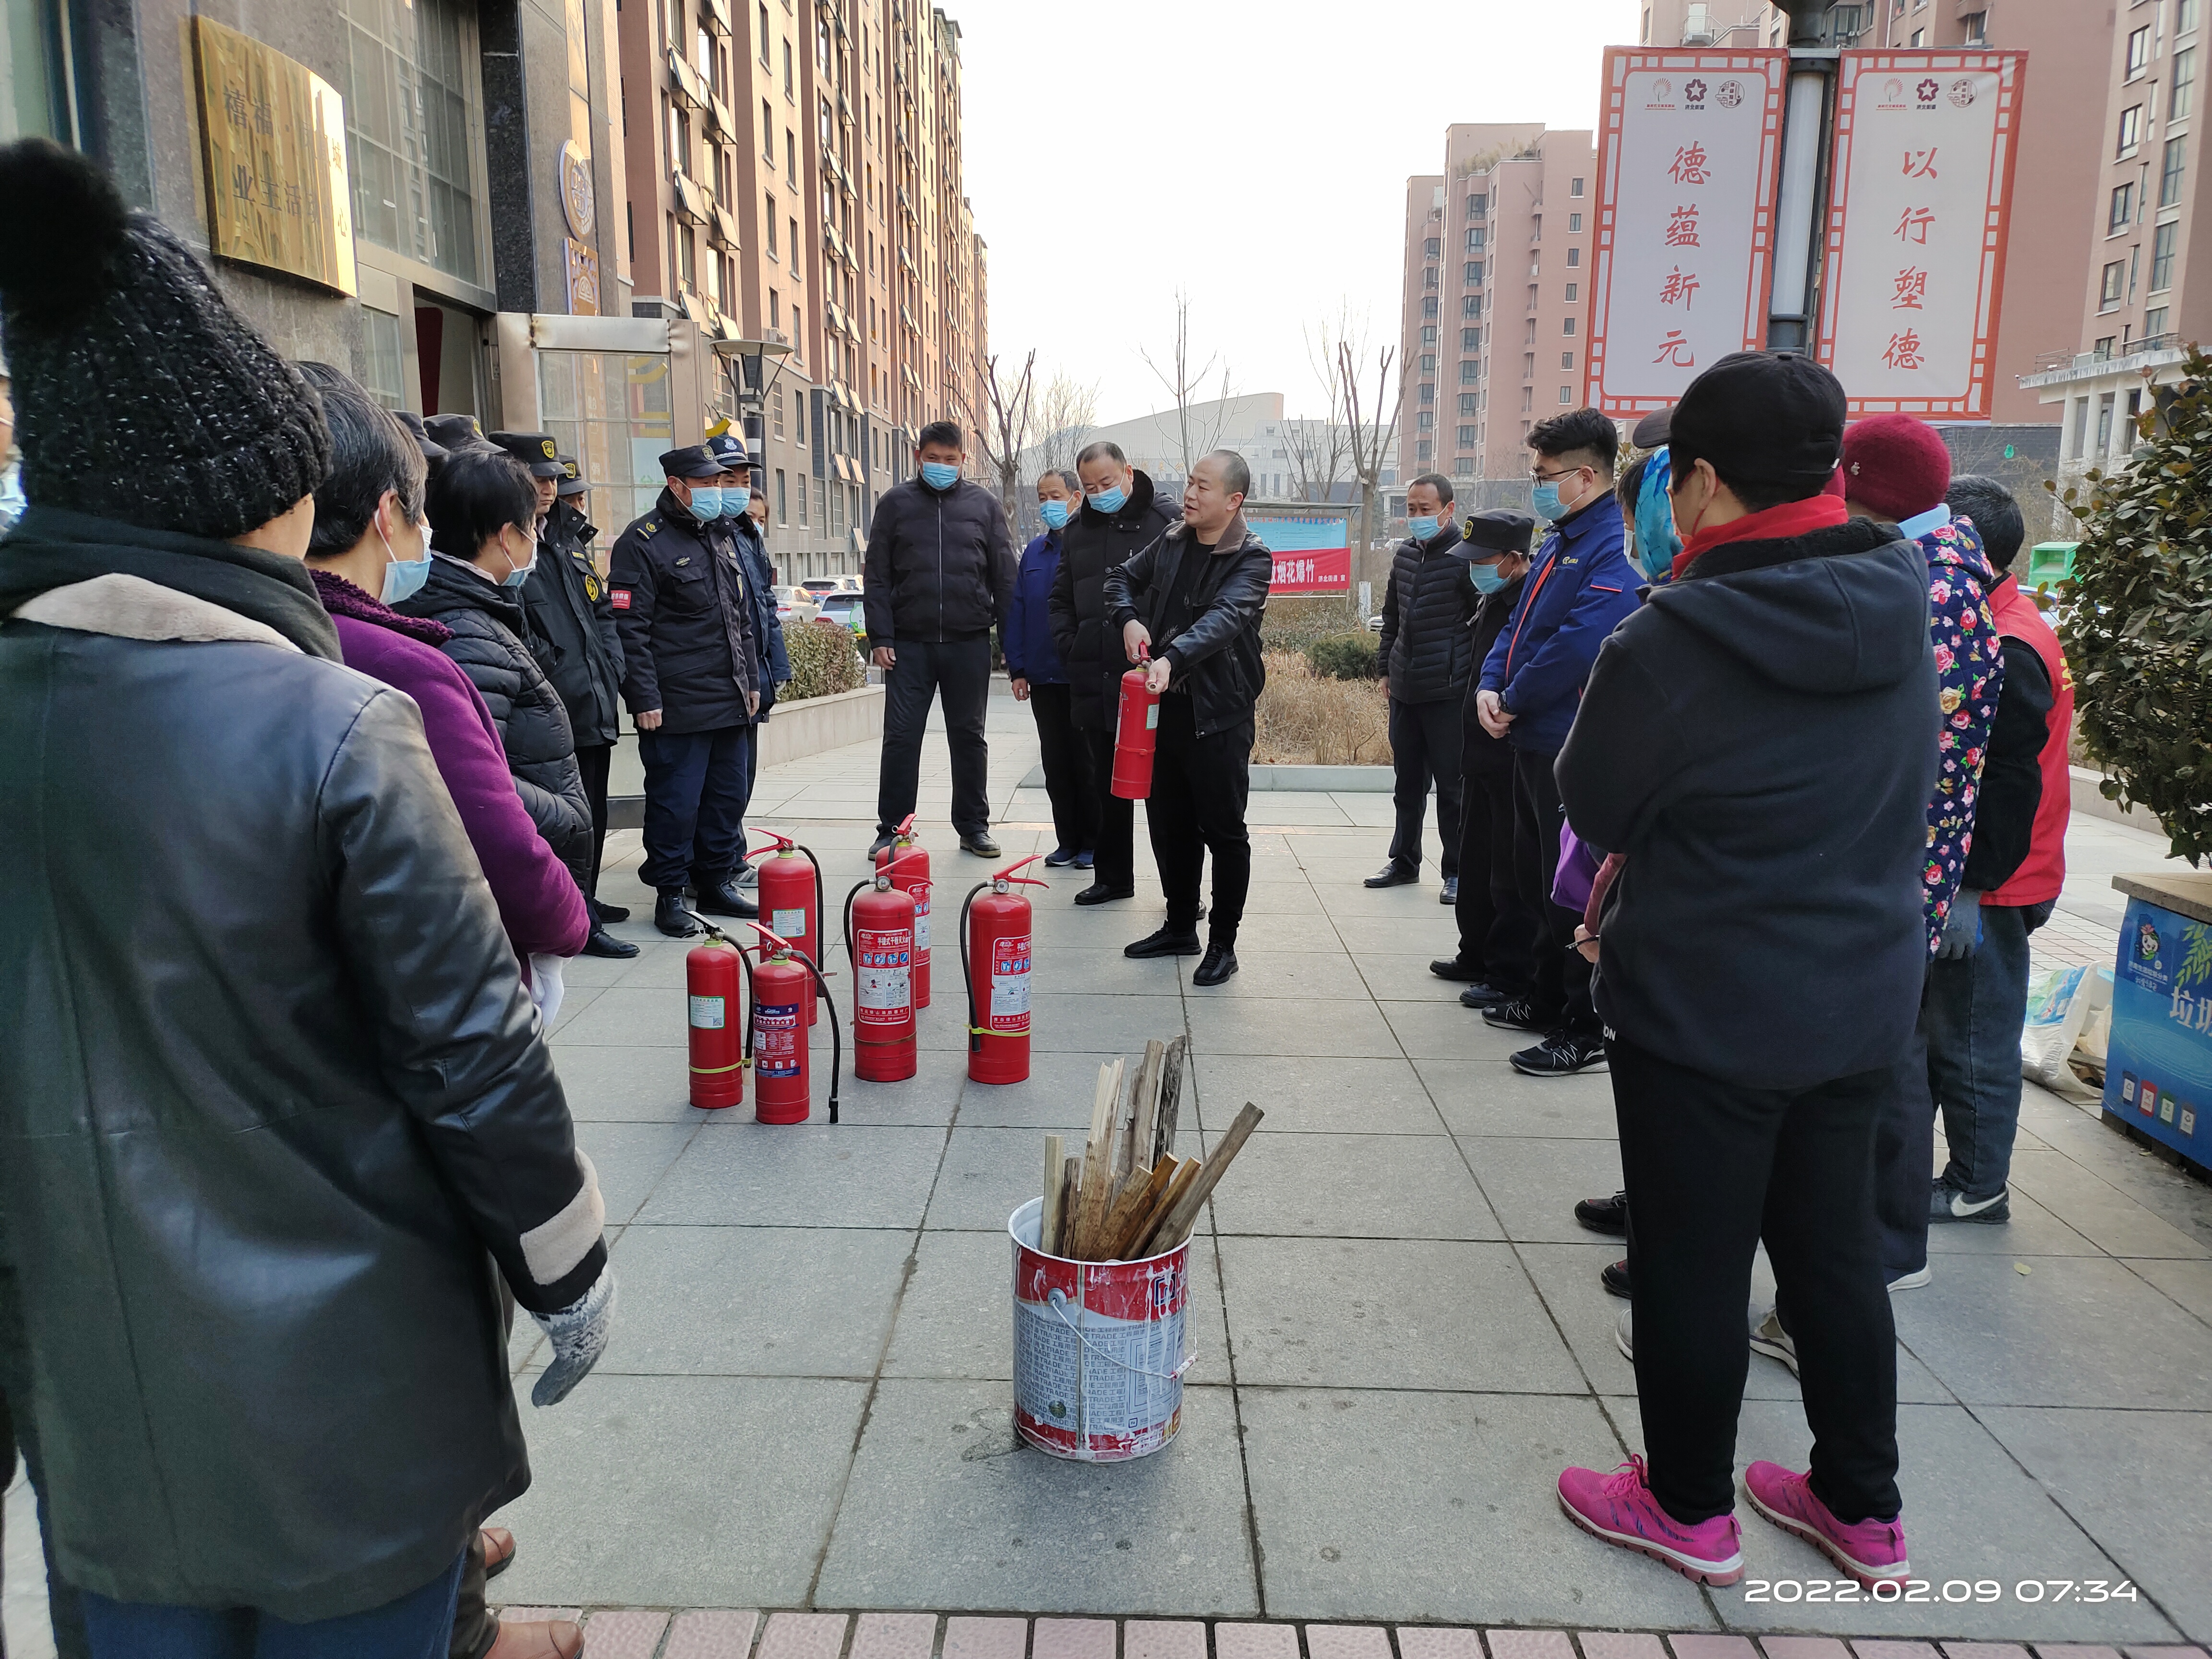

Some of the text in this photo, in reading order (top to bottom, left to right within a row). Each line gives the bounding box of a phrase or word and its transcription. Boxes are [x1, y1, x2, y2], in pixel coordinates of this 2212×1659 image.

[1652, 141, 1711, 367] 德蕴新元
[1881, 147, 1938, 370] 以行塑德
[1039, 1329, 1062, 1340] TRADE
[1046, 1325, 1070, 1336] TRADE
[1046, 1346, 1070, 1357] TRADE
[1039, 1357, 1062, 1368] TRADE
[1039, 1377, 1062, 1390] TRADE
[1046, 1387, 1069, 1398] TRADE
[1046, 1414, 1070, 1426] TRADE
